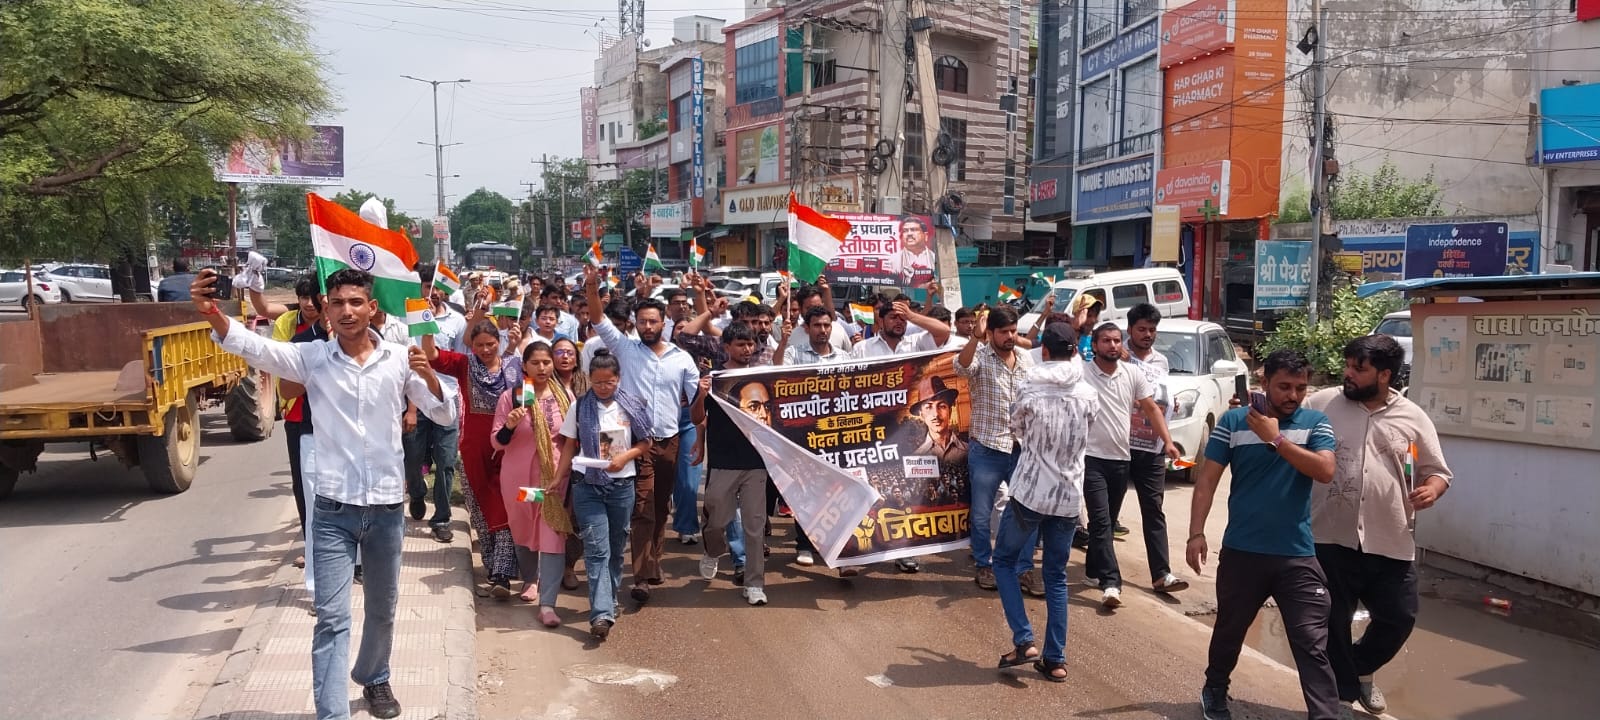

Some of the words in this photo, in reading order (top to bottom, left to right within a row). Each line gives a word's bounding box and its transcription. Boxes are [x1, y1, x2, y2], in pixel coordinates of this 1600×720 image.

[1087, 54, 1099, 72] CT
[1103, 35, 1132, 66] SCAN
[1134, 22, 1156, 48] MRI
[1173, 77, 1190, 92] HAR
[1191, 69, 1214, 86] GHAR
[1215, 66, 1225, 79] KI
[693, 60, 703, 129] DENTAL
[1173, 82, 1225, 108] PHARMACY
[585, 109, 594, 142] HOTEL
[1555, 149, 1598, 160] ENTERPRISES
[1080, 172, 1103, 193] UNIQUE
[1104, 161, 1152, 188] DIAGNOSTICS
[1174, 172, 1211, 188] davaindia
[739, 198, 755, 213] OLD
[838, 235, 881, 254] स्तीफा
[884, 235, 898, 254] दो
[1428, 234, 1482, 248] Independence
[1259, 255, 1277, 282] श्री
[1279, 255, 1299, 282] पैथ
[1472, 314, 1526, 336] बाबा
[1527, 307, 1600, 337] कनफै
[774, 374, 836, 398] विद्यार्थियों
[838, 374, 852, 390] के
[854, 372, 884, 388] साथ
[886, 366, 904, 388] हुई
[779, 394, 831, 420] मारपीट
[833, 391, 860, 412] और
[861, 388, 908, 409] अन्याय
[827, 416, 836, 428] के
[807, 431, 839, 449] पैदल
[842, 424, 873, 445] मार्च
[874, 425, 886, 440] व
[843, 441, 900, 468] प्रदर्शन
[877, 506, 970, 542] जिंदाबाद
